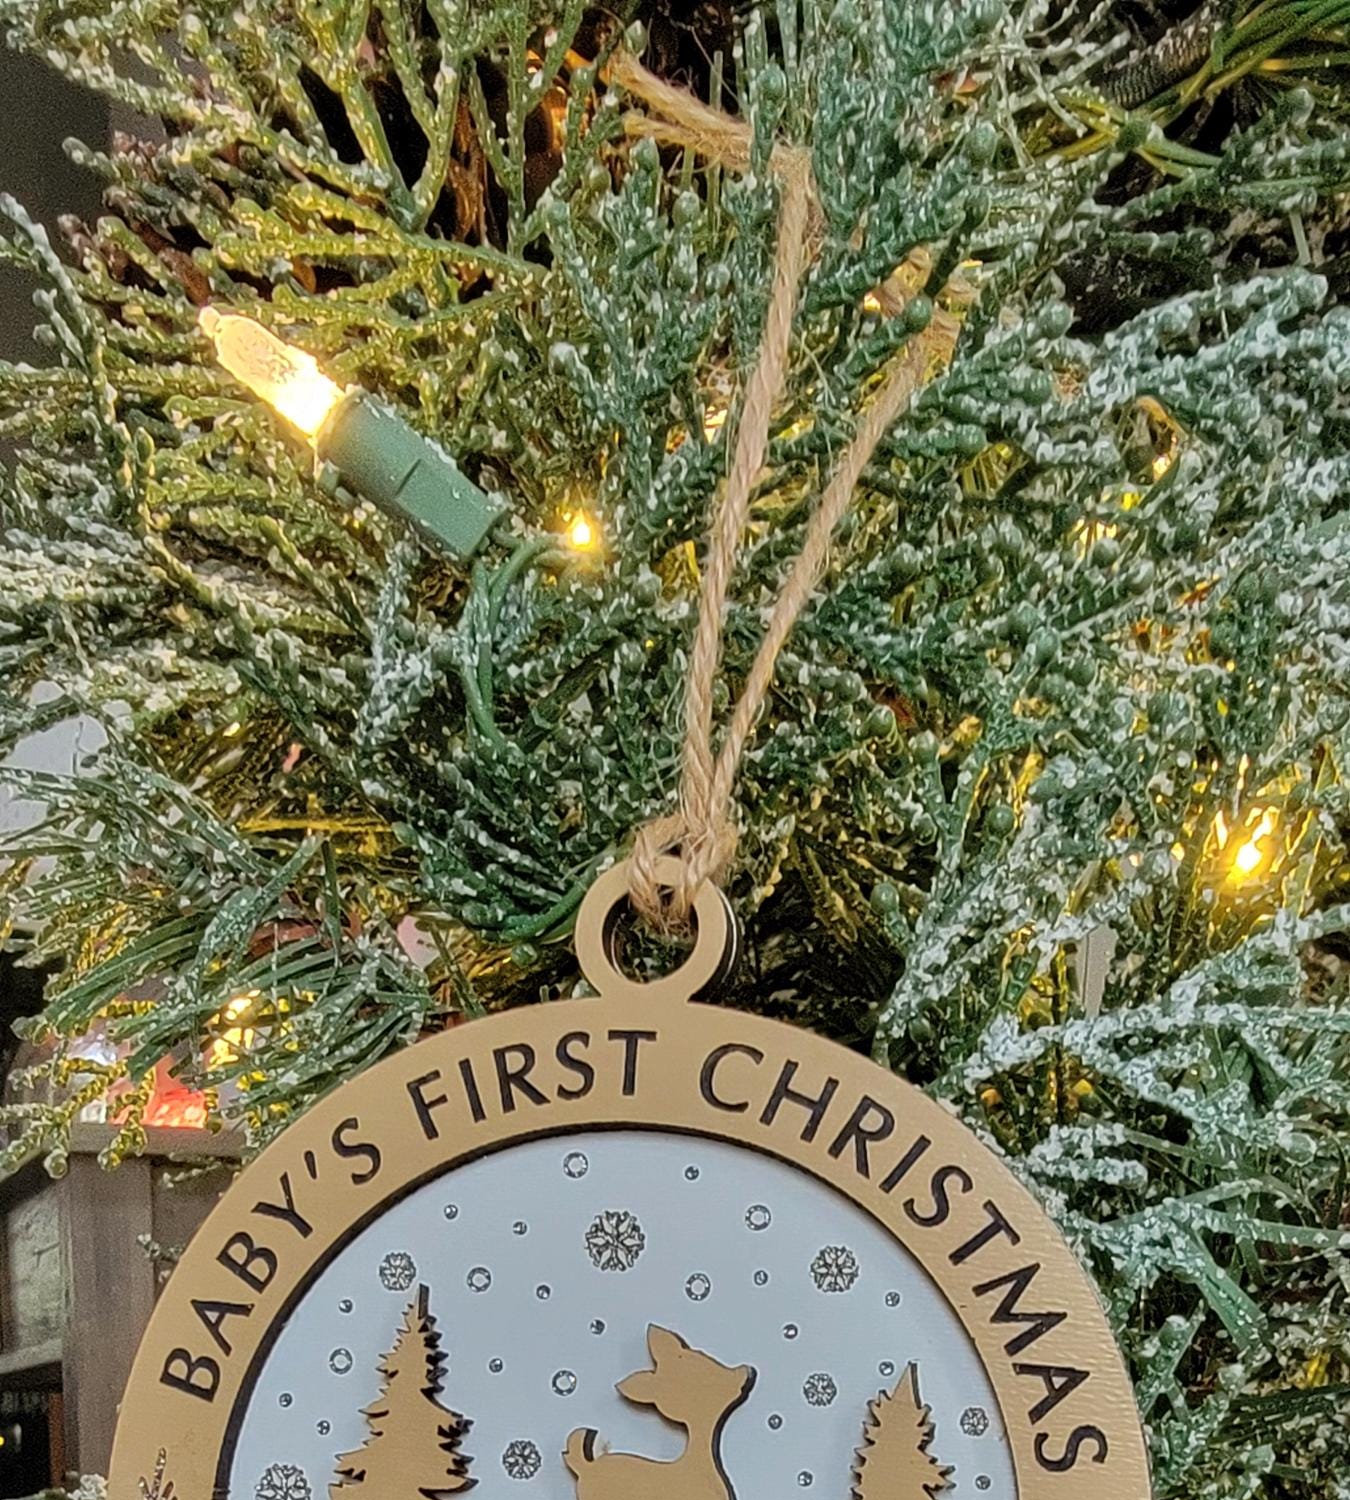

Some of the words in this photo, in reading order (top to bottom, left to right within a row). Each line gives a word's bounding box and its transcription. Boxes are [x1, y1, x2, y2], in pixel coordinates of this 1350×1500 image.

[160, 1116, 382, 1403] BABY'S
[405, 1028, 658, 1141] FIRST
[699, 1042, 1109, 1475] CHRISTMAS
